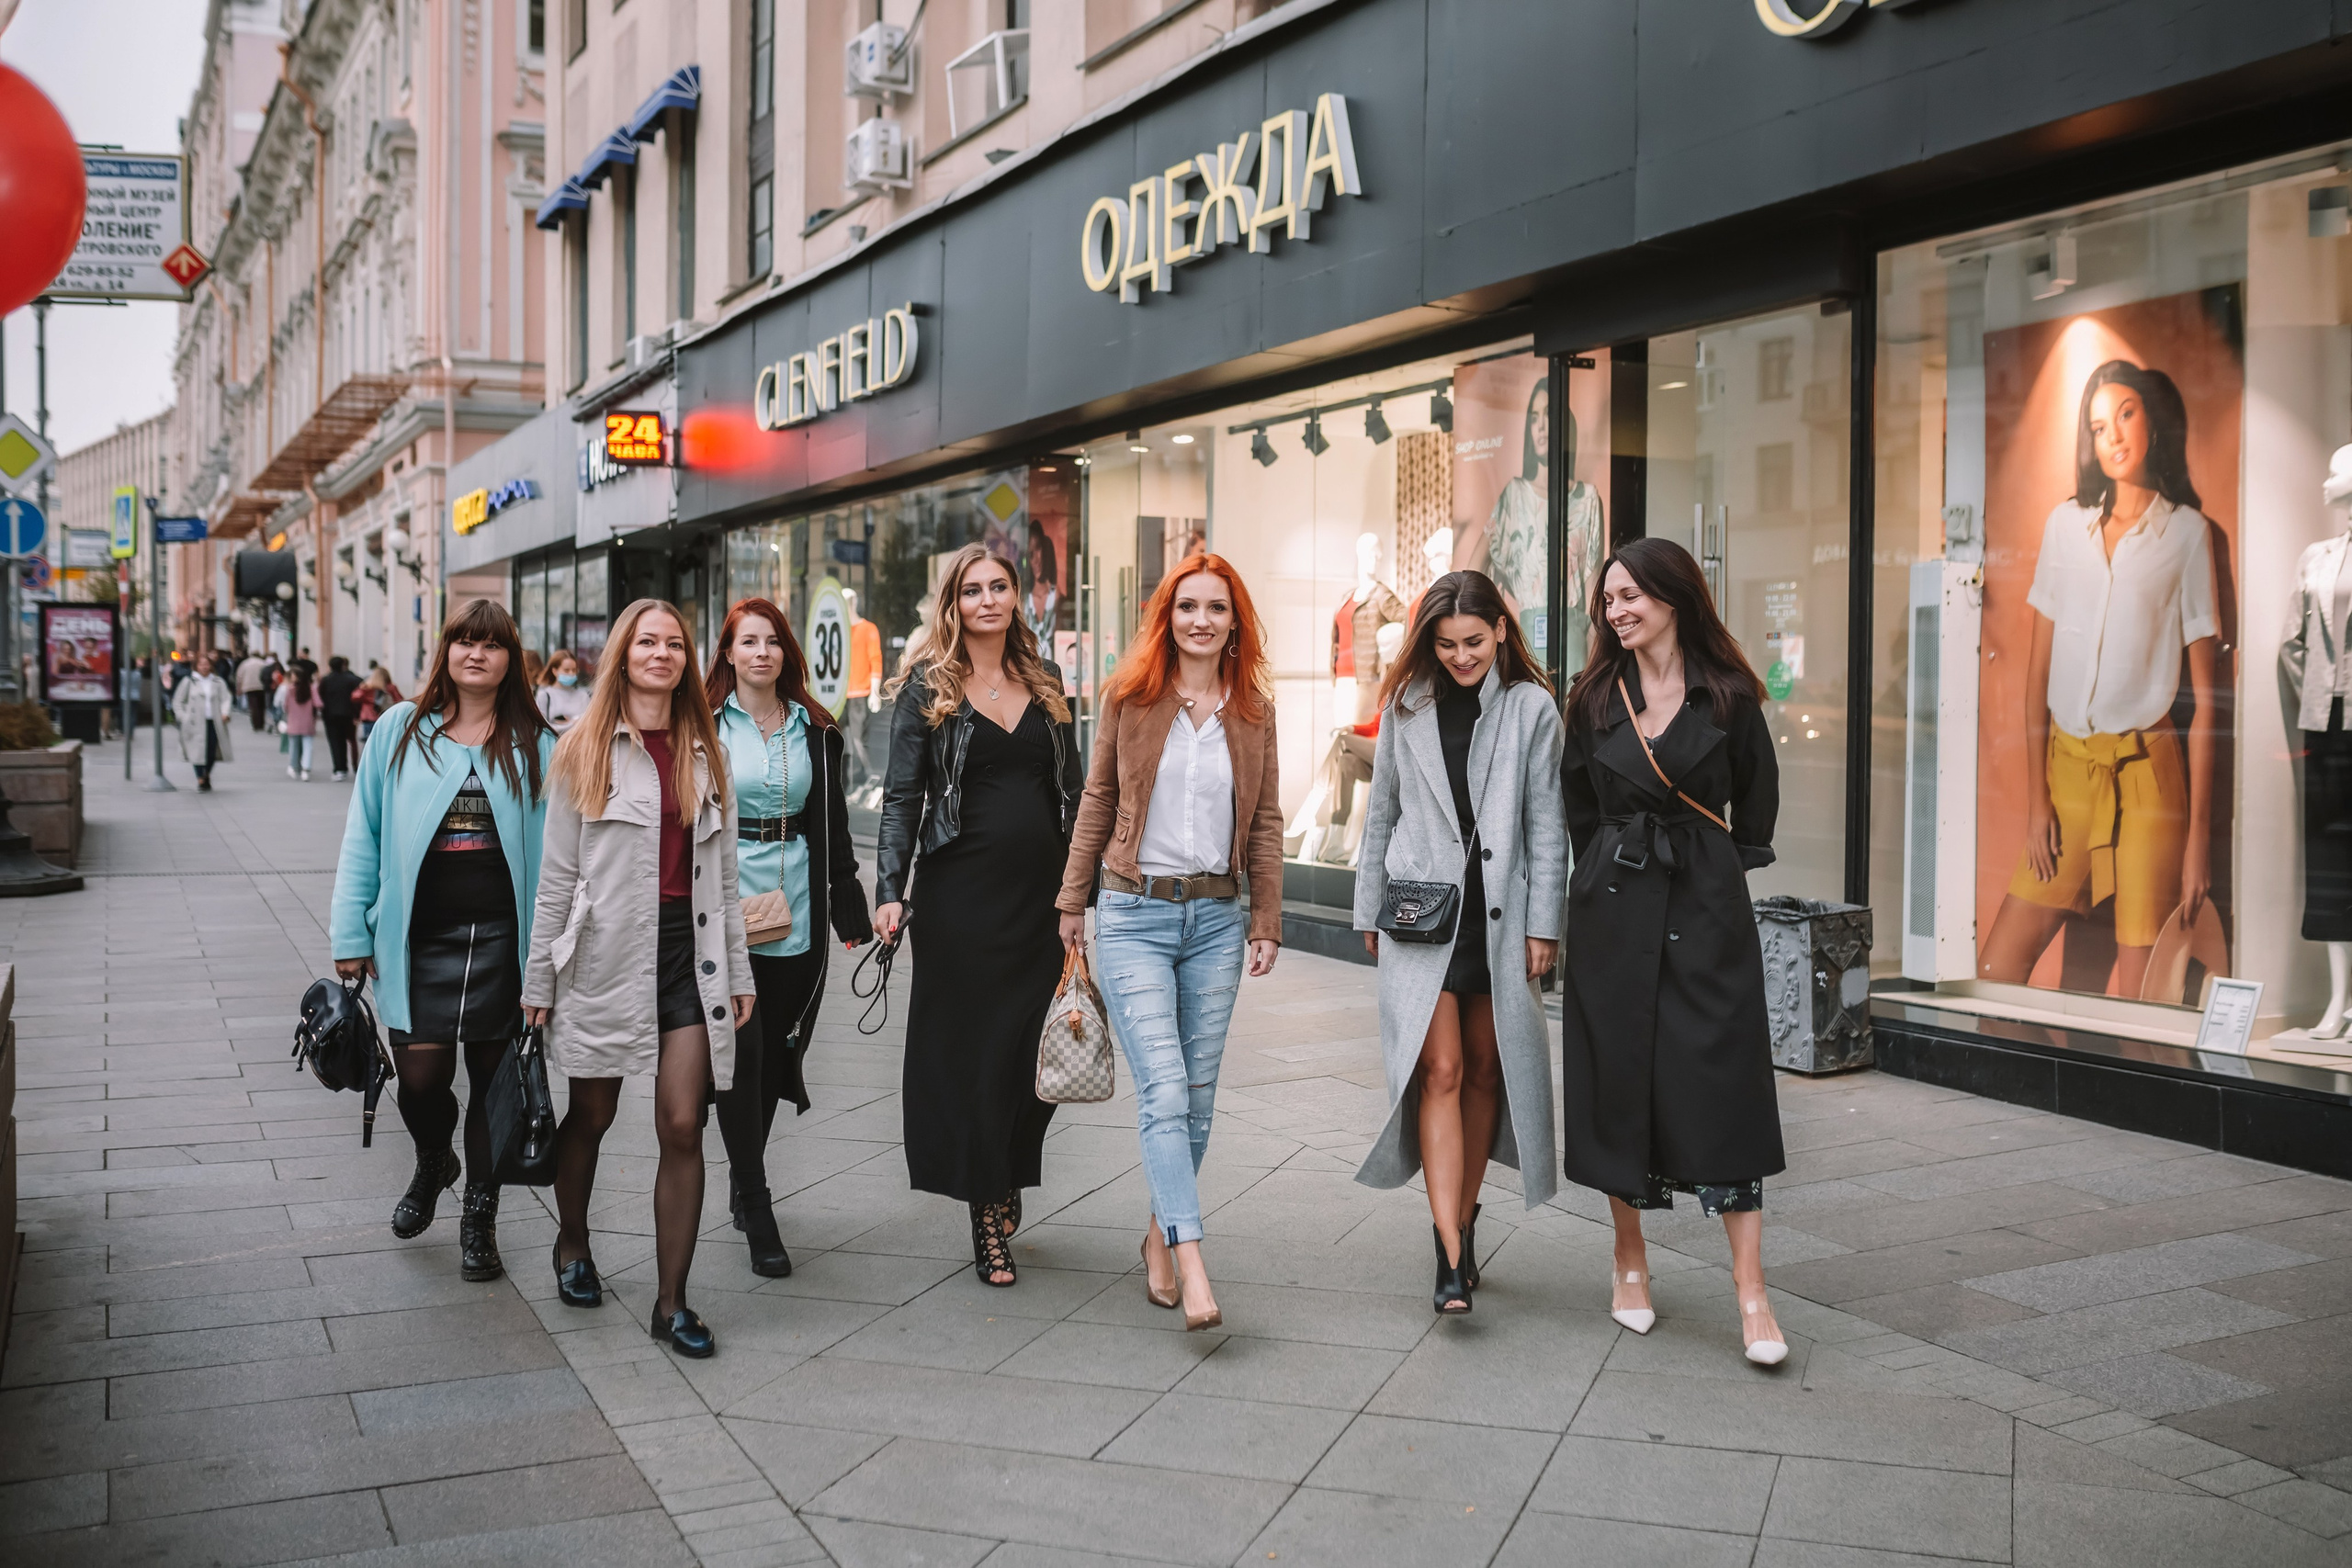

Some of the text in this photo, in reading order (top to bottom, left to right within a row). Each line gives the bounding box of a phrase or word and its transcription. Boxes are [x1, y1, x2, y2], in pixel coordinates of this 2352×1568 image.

[130, 187, 175, 202] МУЗЕЙ
[1081, 92, 1361, 304] ОДЕЖДА
[119, 206, 162, 219] ЦЕНТР
[606, 414, 662, 445] 24
[1454, 434, 1504, 455] SHOP ONLINE
[814, 622, 842, 680] 30
